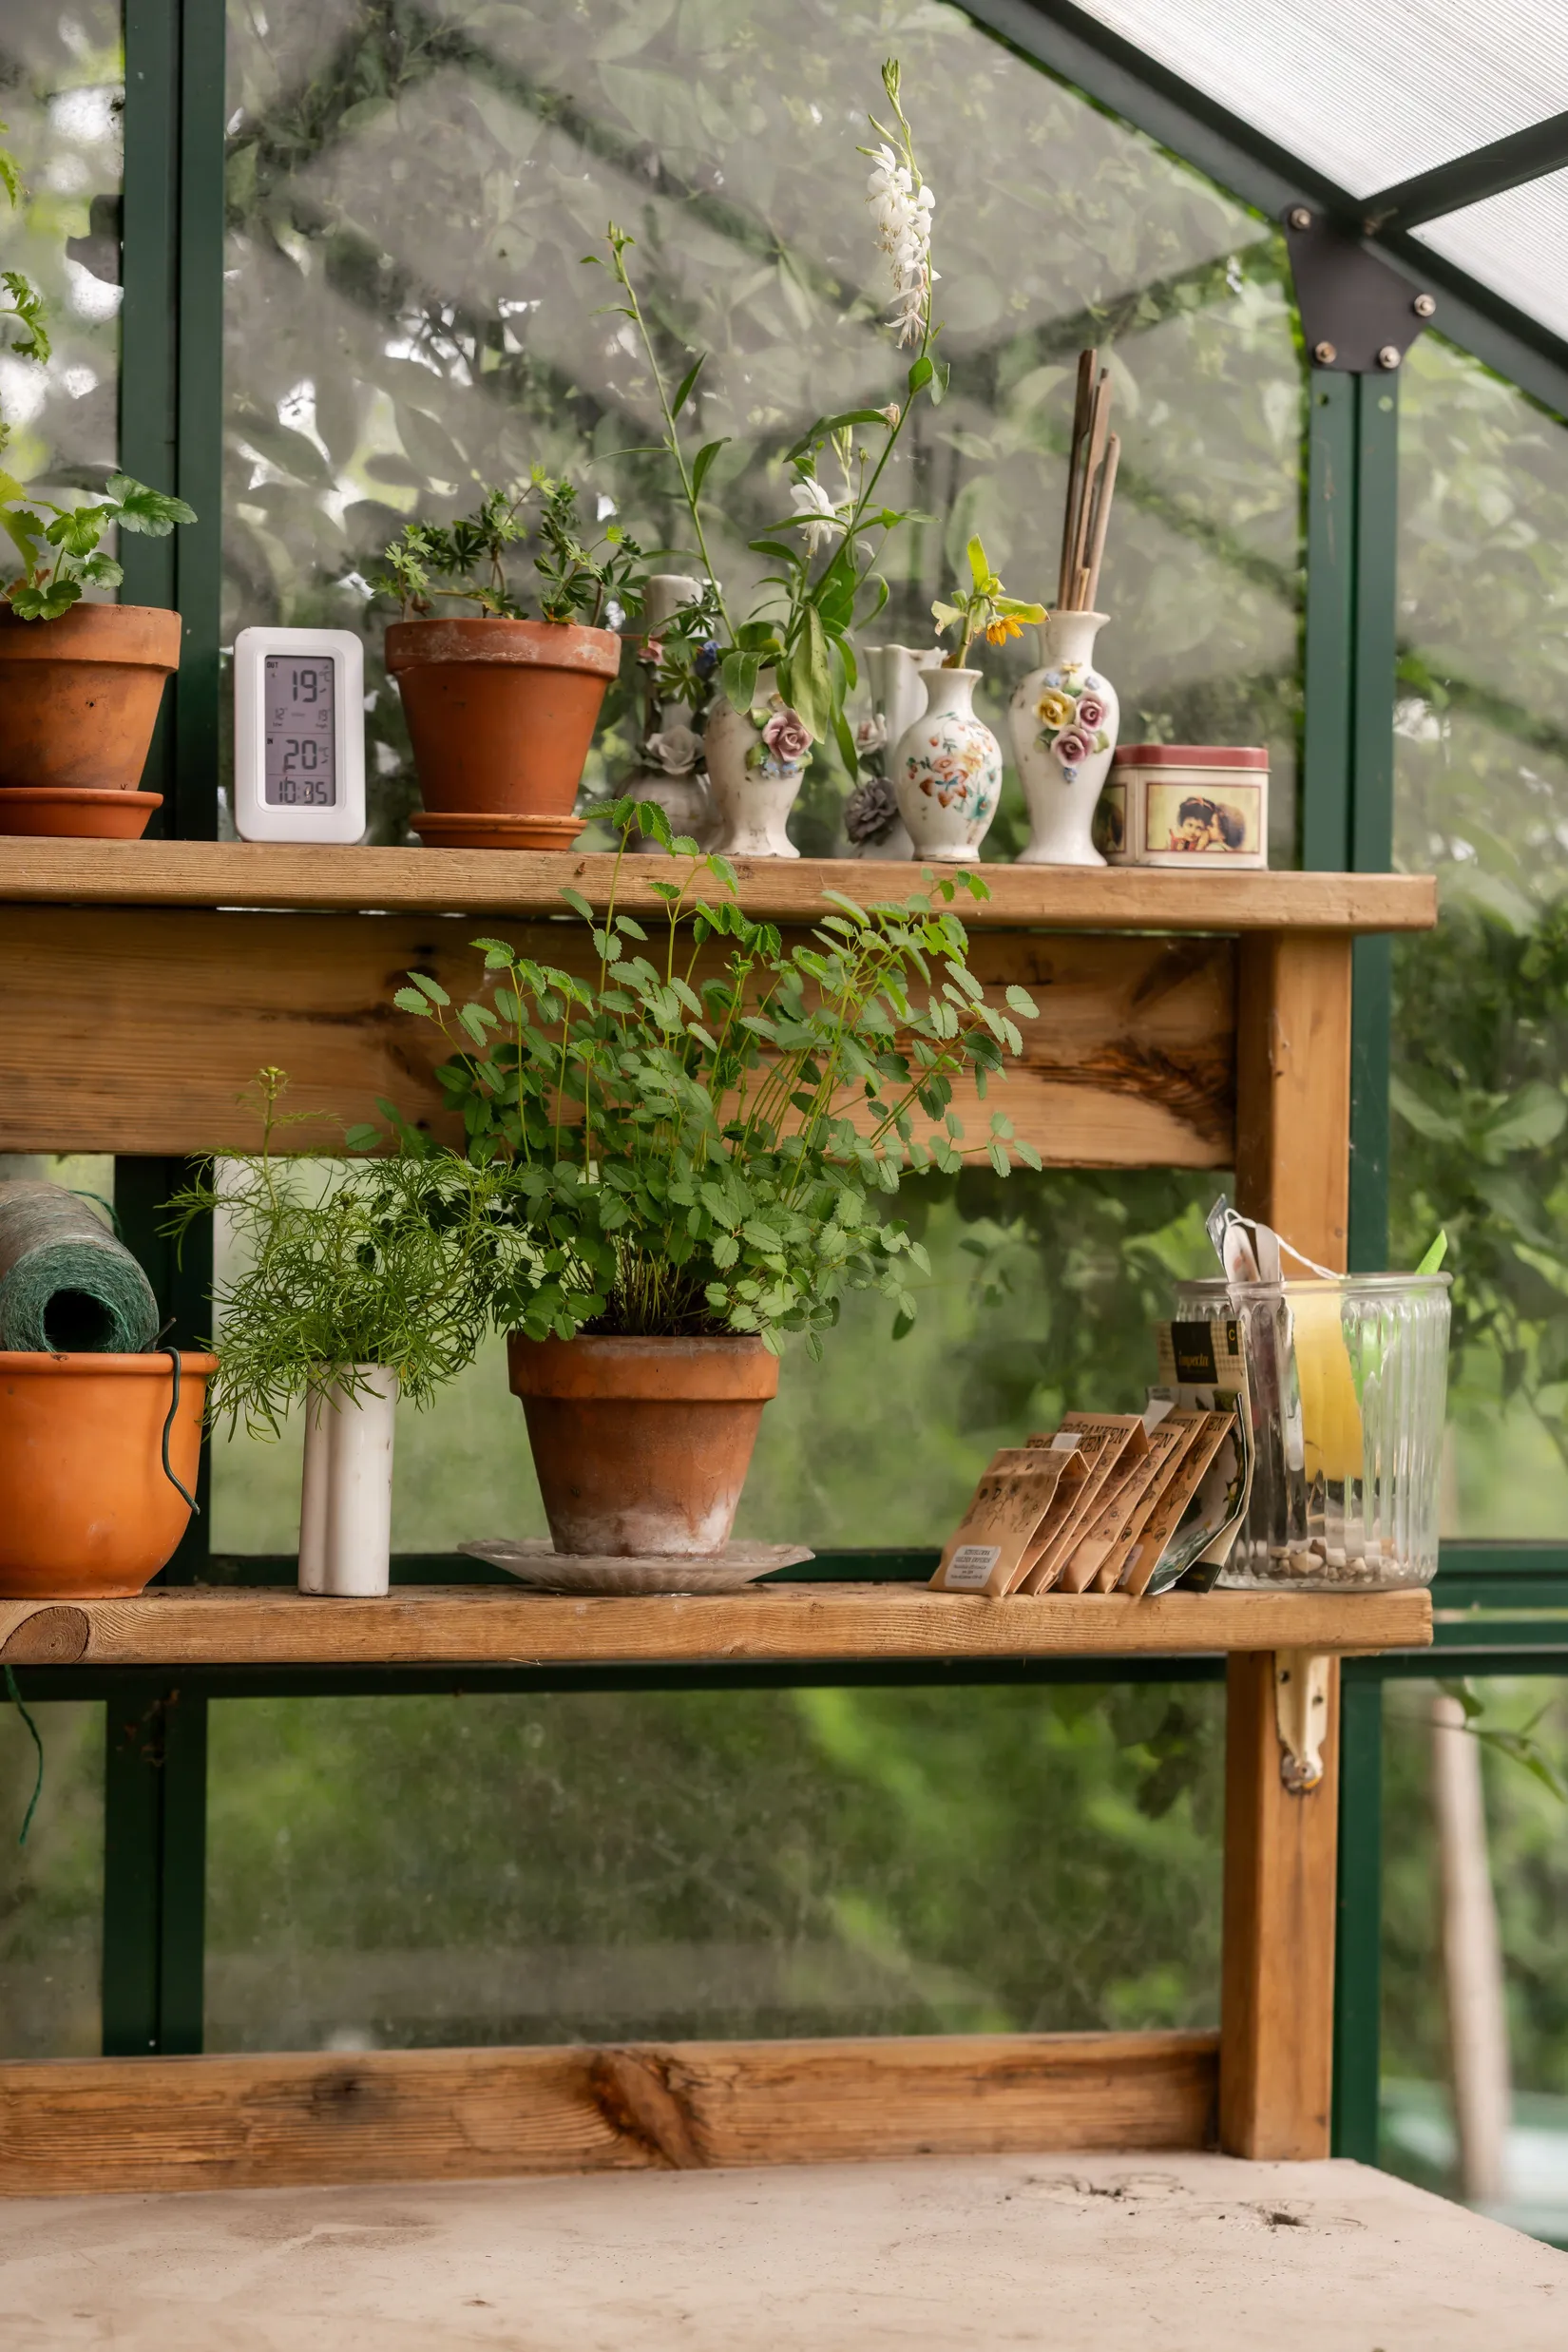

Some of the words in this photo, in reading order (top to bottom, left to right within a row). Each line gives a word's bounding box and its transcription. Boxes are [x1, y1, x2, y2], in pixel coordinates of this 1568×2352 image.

[293, 670, 317, 702] 19
[283, 739, 317, 770] 20
[1228, 1329, 1236, 1341] C
